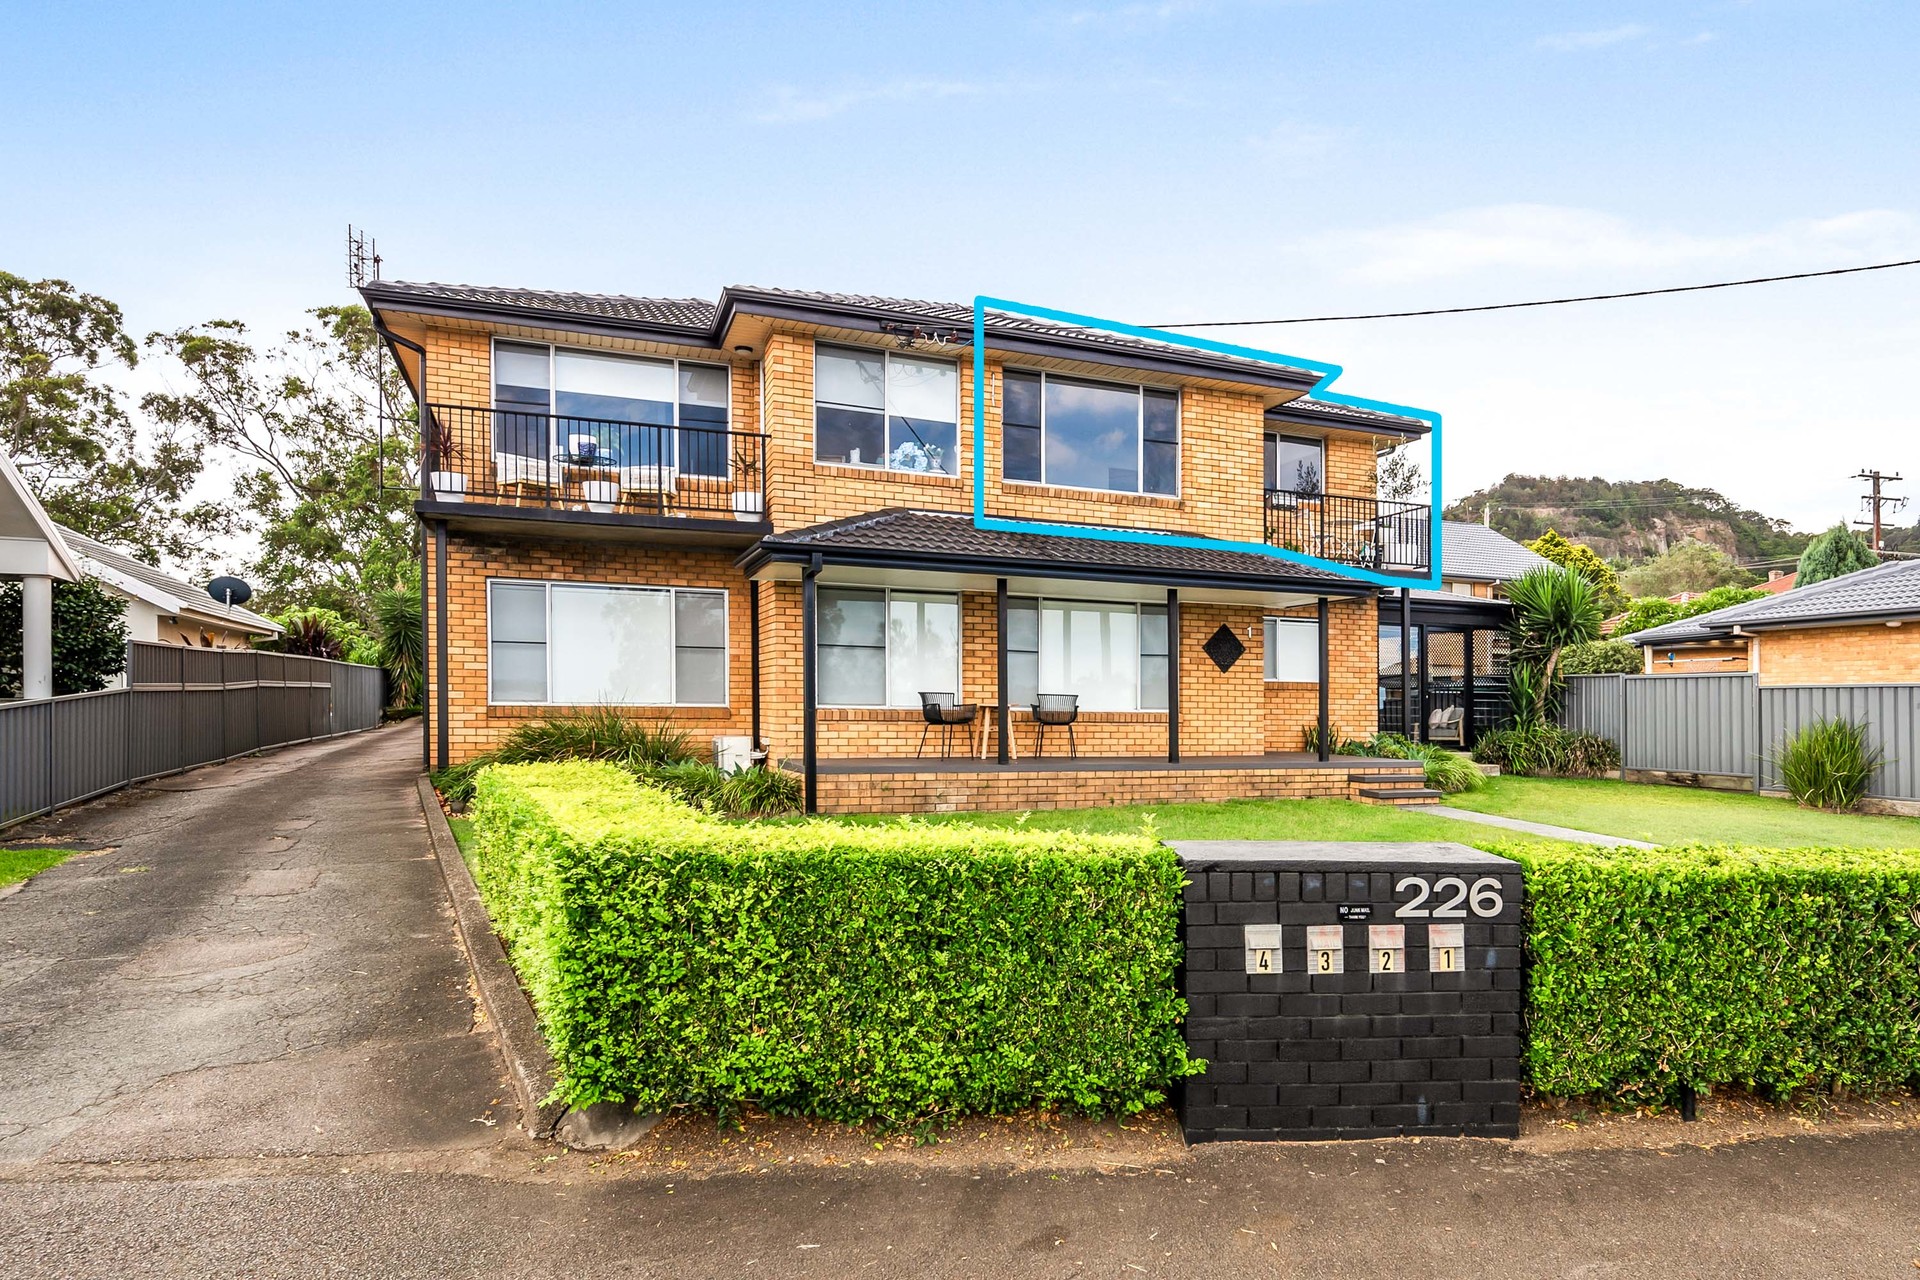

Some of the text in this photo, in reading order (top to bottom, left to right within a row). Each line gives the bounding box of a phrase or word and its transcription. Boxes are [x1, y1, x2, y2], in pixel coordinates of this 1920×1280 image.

[1247, 626, 1252, 638] 1
[1395, 876, 1503, 918] 226
[1339, 906, 1349, 914] NO
[1259, 951, 1269, 970] 4
[1321, 951, 1330, 971] 3
[1382, 951, 1391, 971] 2
[1444, 949, 1451, 969] 1
